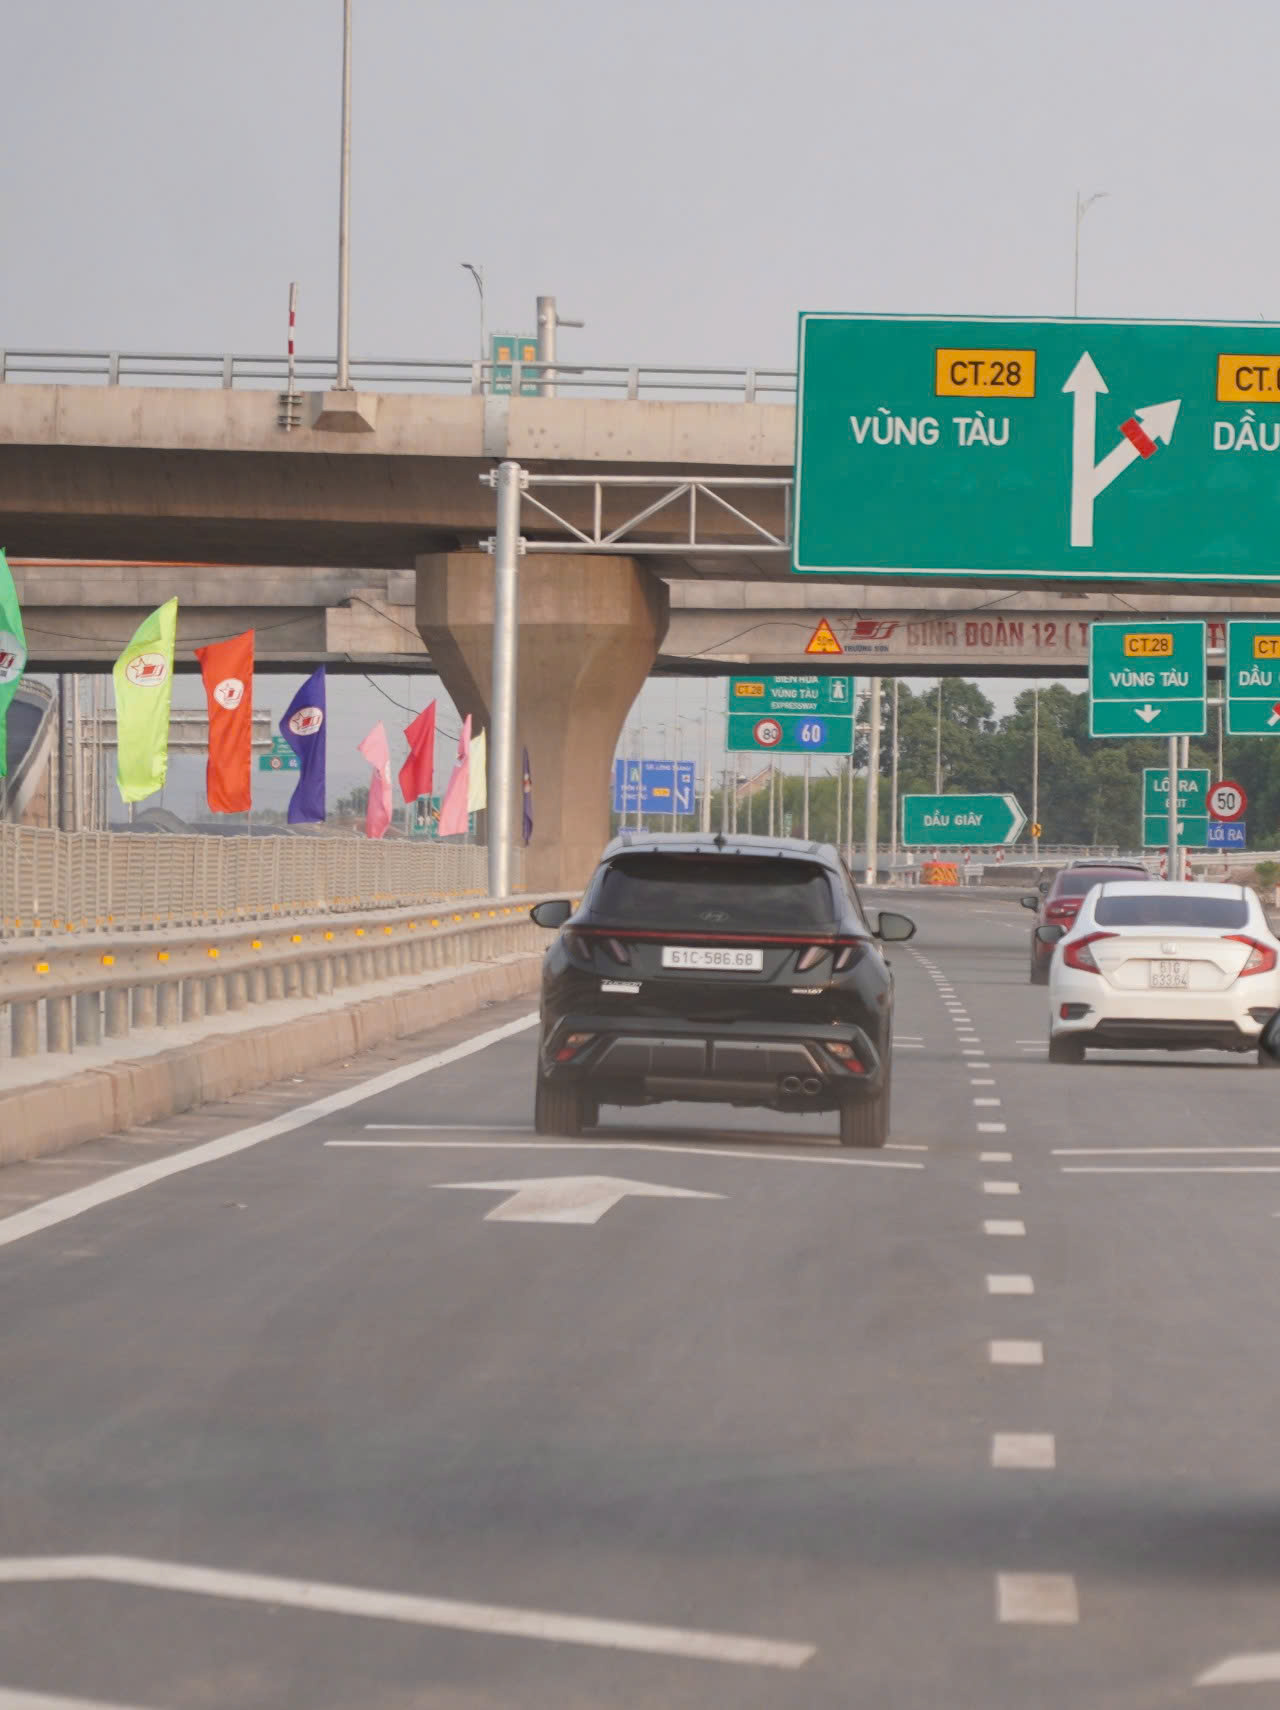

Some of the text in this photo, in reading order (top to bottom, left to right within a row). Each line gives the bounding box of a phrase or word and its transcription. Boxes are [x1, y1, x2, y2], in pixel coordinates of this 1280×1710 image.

[950, 360, 1021, 386] CT.28
[850, 407, 1010, 446] VŨNG TÀU
[1213, 409, 1280, 453] DẦU
[965, 616, 1024, 647] ĐOÀN
[1032, 622, 1057, 647] 12
[1129, 638, 1169, 652] CT.28
[1109, 668, 1189, 687] VŨNG TÀU
[1239, 664, 1272, 686] DẦU
[800, 686, 819, 699] TÀU
[763, 728, 778, 740] 80
[802, 724, 821, 742] 60
[1179, 780, 1199, 792] RA
[1217, 792, 1236, 810] 50
[924, 809, 983, 826] DẦU GIÂY
[1228, 828, 1244, 841] RA
